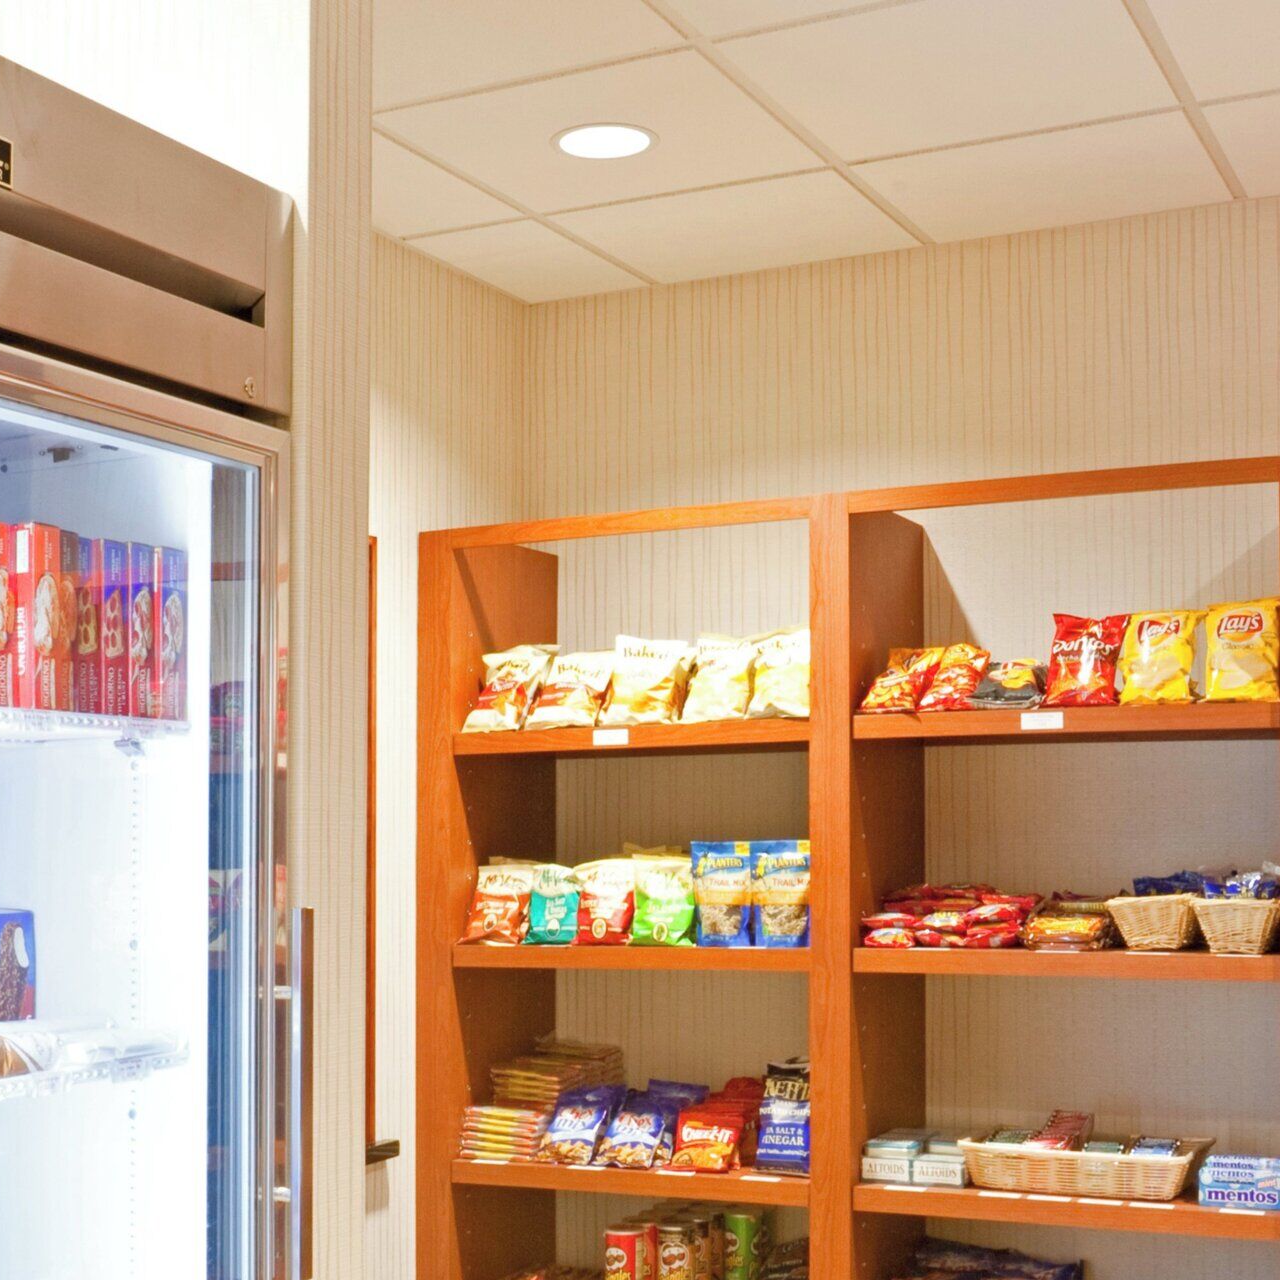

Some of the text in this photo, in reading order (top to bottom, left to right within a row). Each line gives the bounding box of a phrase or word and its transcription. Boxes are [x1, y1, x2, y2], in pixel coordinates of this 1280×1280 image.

[1141, 619, 1181, 640] Lay's
[1219, 612, 1263, 634] Lay's
[707, 855, 743, 869] PLANTERS
[770, 856, 807, 869] PLANTERS
[772, 878, 793, 887] TRAIL
[867, 1162, 905, 1174] ALTOIDS
[919, 1166, 957, 1178] ALTOIDS
[1207, 1189, 1277, 1203] mentos
